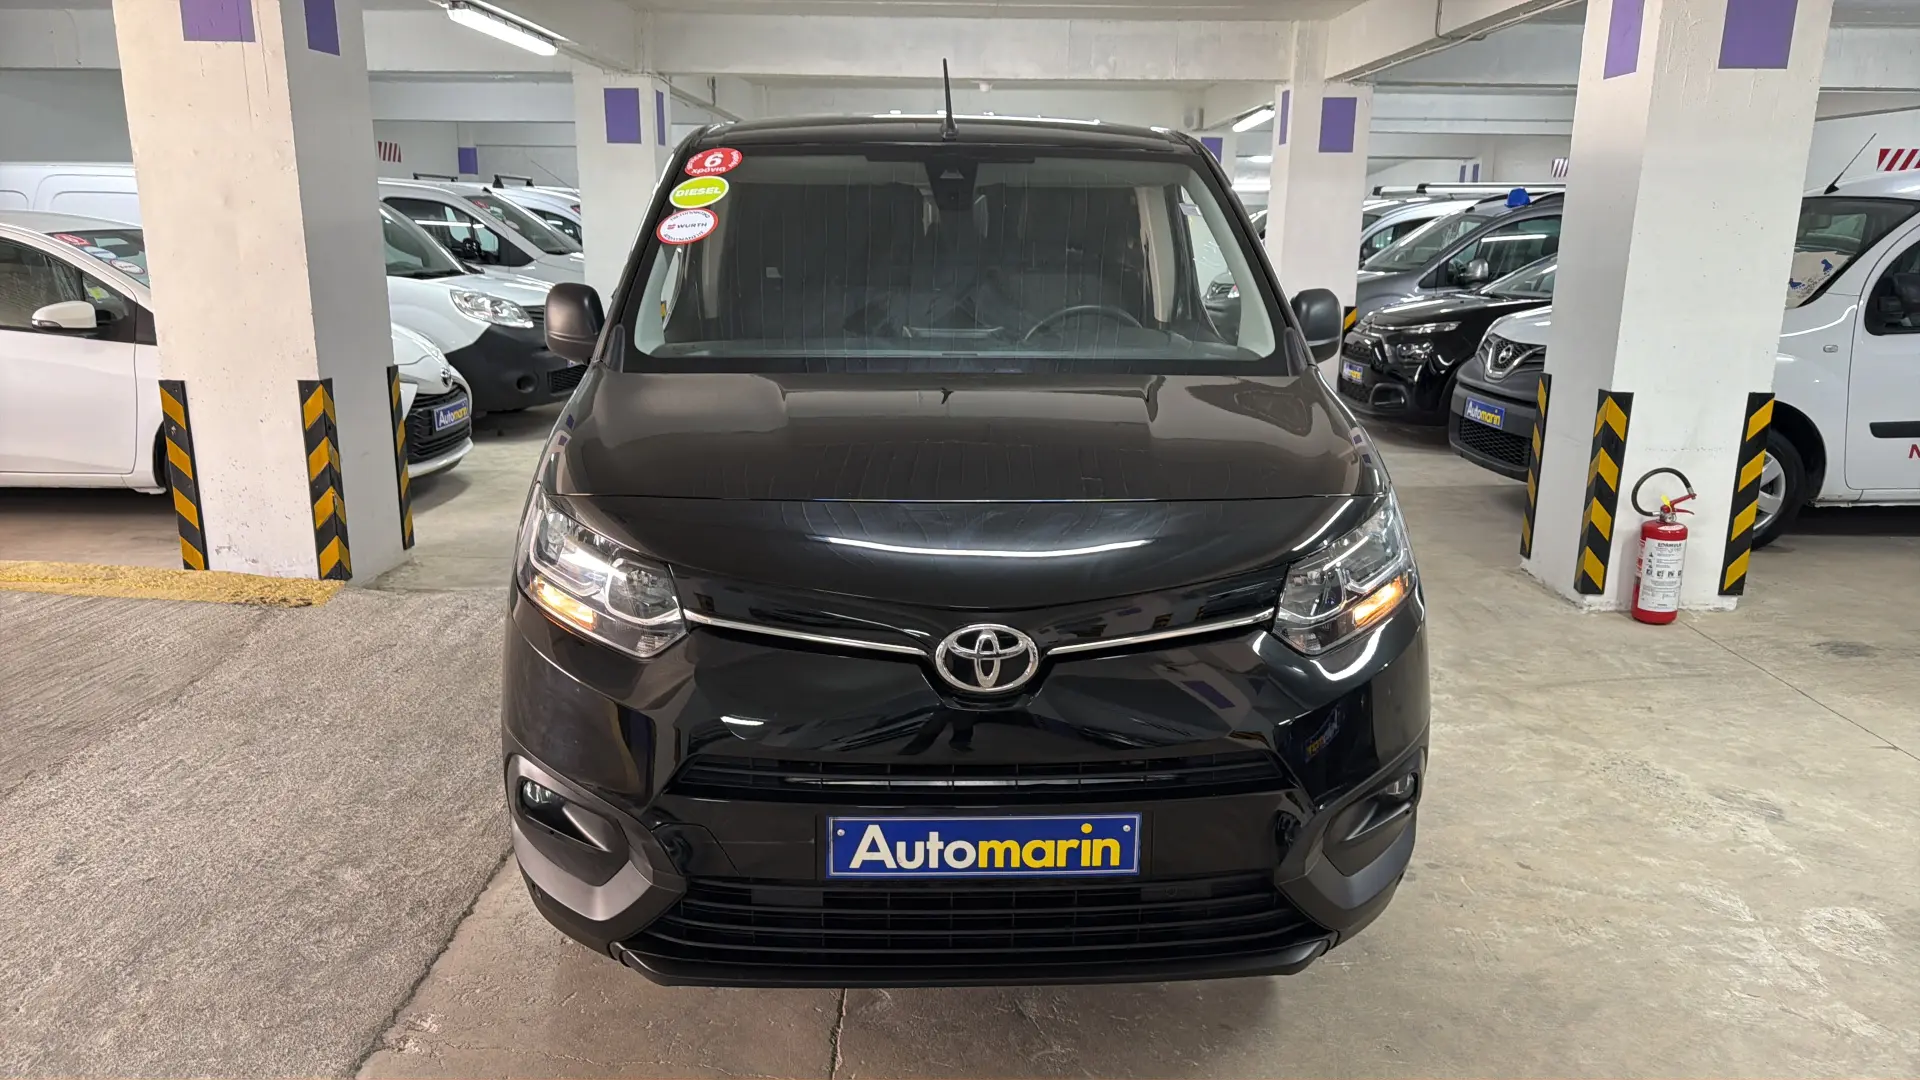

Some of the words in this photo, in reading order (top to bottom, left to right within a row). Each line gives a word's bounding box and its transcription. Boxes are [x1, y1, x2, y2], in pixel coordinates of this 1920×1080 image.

[704, 154, 724, 168] 6
[676, 187, 721, 197] DIESEL
[1467, 401, 1500, 426] Automarin
[849, 823, 1120, 869] Automarin
